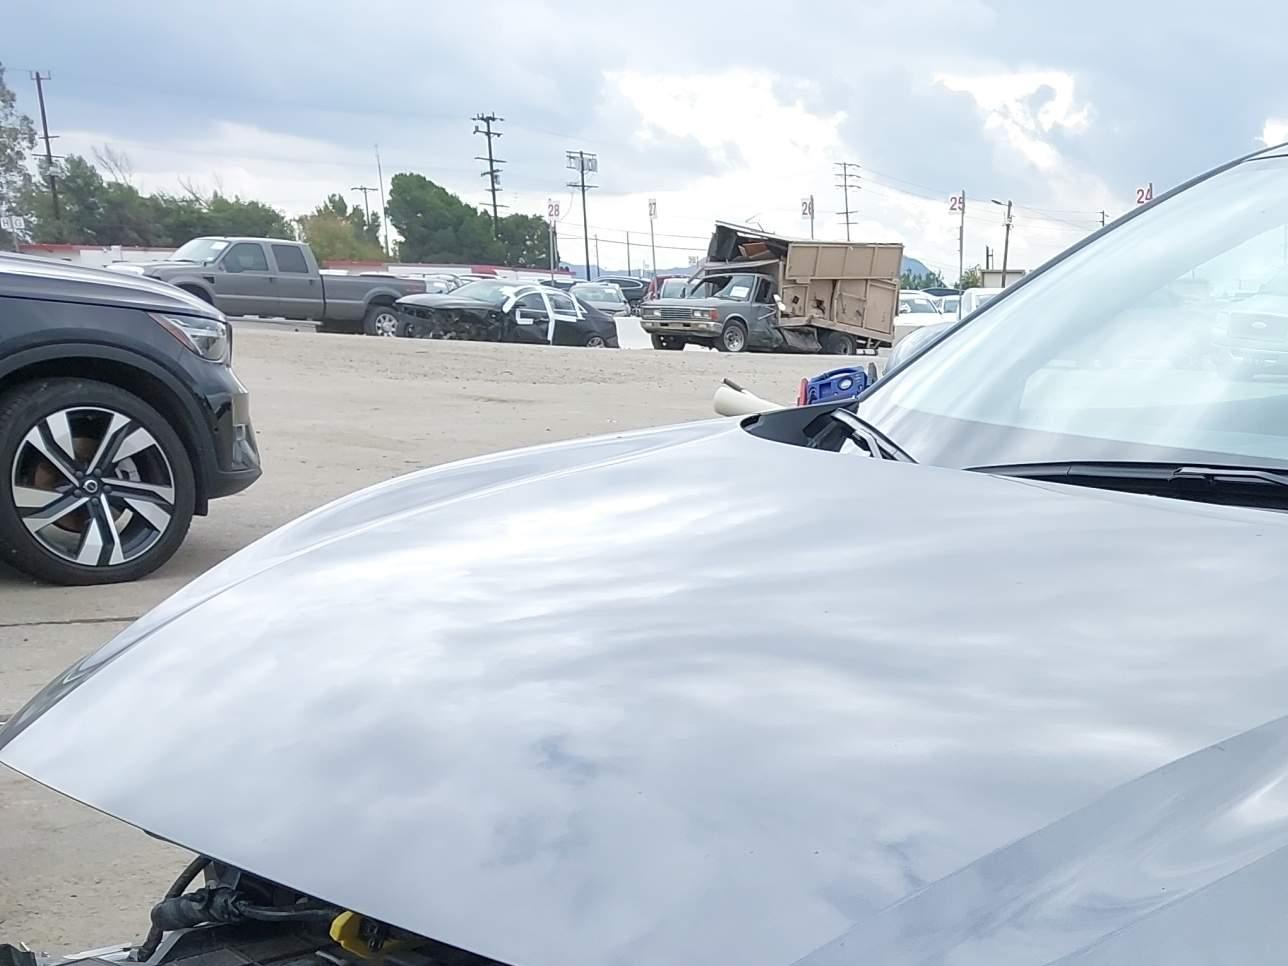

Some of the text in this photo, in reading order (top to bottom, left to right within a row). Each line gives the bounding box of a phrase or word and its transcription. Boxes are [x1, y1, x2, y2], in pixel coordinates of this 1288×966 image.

[950, 196, 965, 211] 25
[1136, 188, 1152, 204] 24
[548, 203, 560, 217] 28
[648, 202, 657, 217] 27
